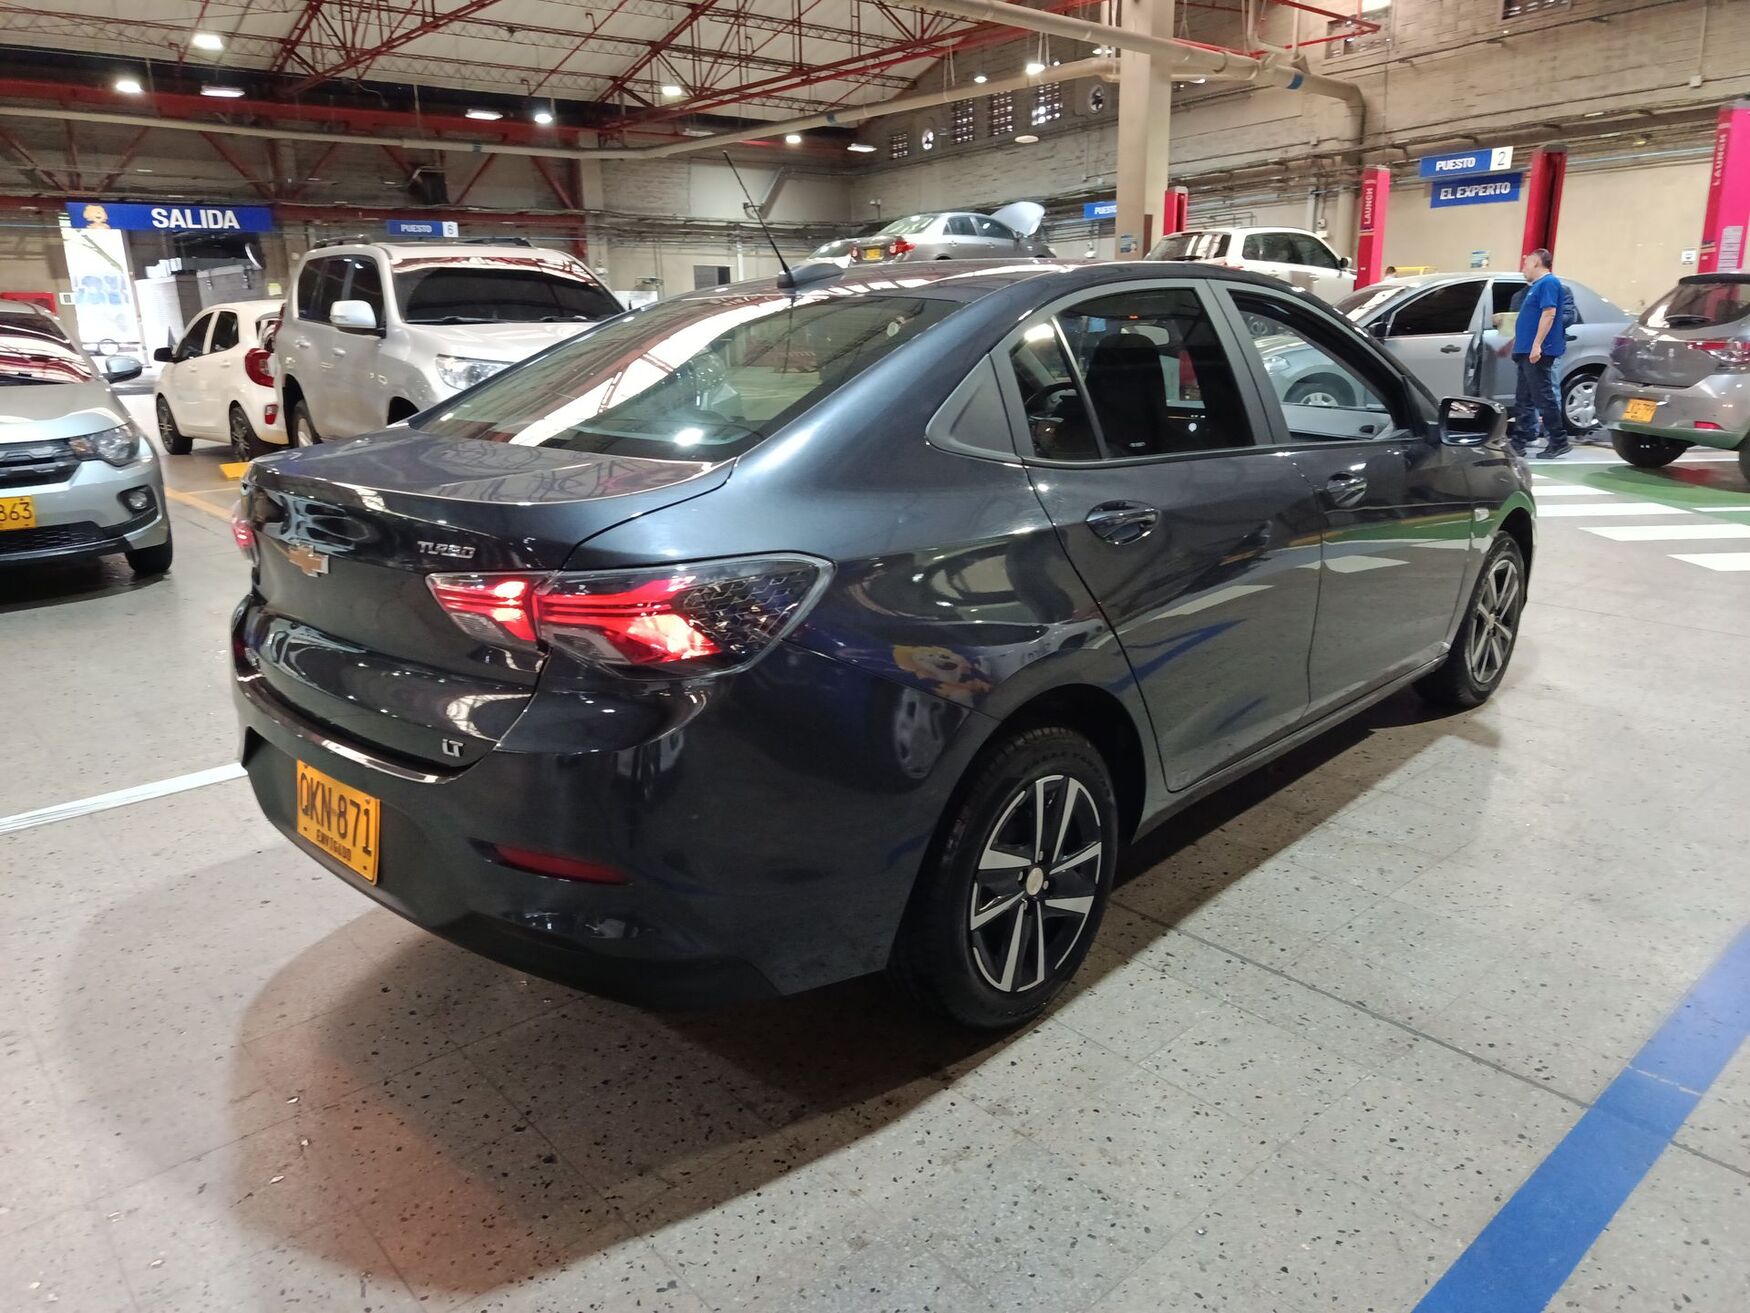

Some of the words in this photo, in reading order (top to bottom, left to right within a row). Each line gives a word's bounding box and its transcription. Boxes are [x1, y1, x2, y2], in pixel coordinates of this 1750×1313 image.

[1435, 157, 1476, 171] PUESTO
[1497, 151, 1505, 166] 2
[1439, 189, 1455, 200] EL
[1456, 182, 1510, 199] EXPERTO
[1363, 187, 1374, 225] LAUNCH
[151, 208, 240, 229] SALIDA
[400, 224, 432, 233] PUESTO
[447, 224, 454, 235] 6
[417, 540, 476, 559] TURBO
